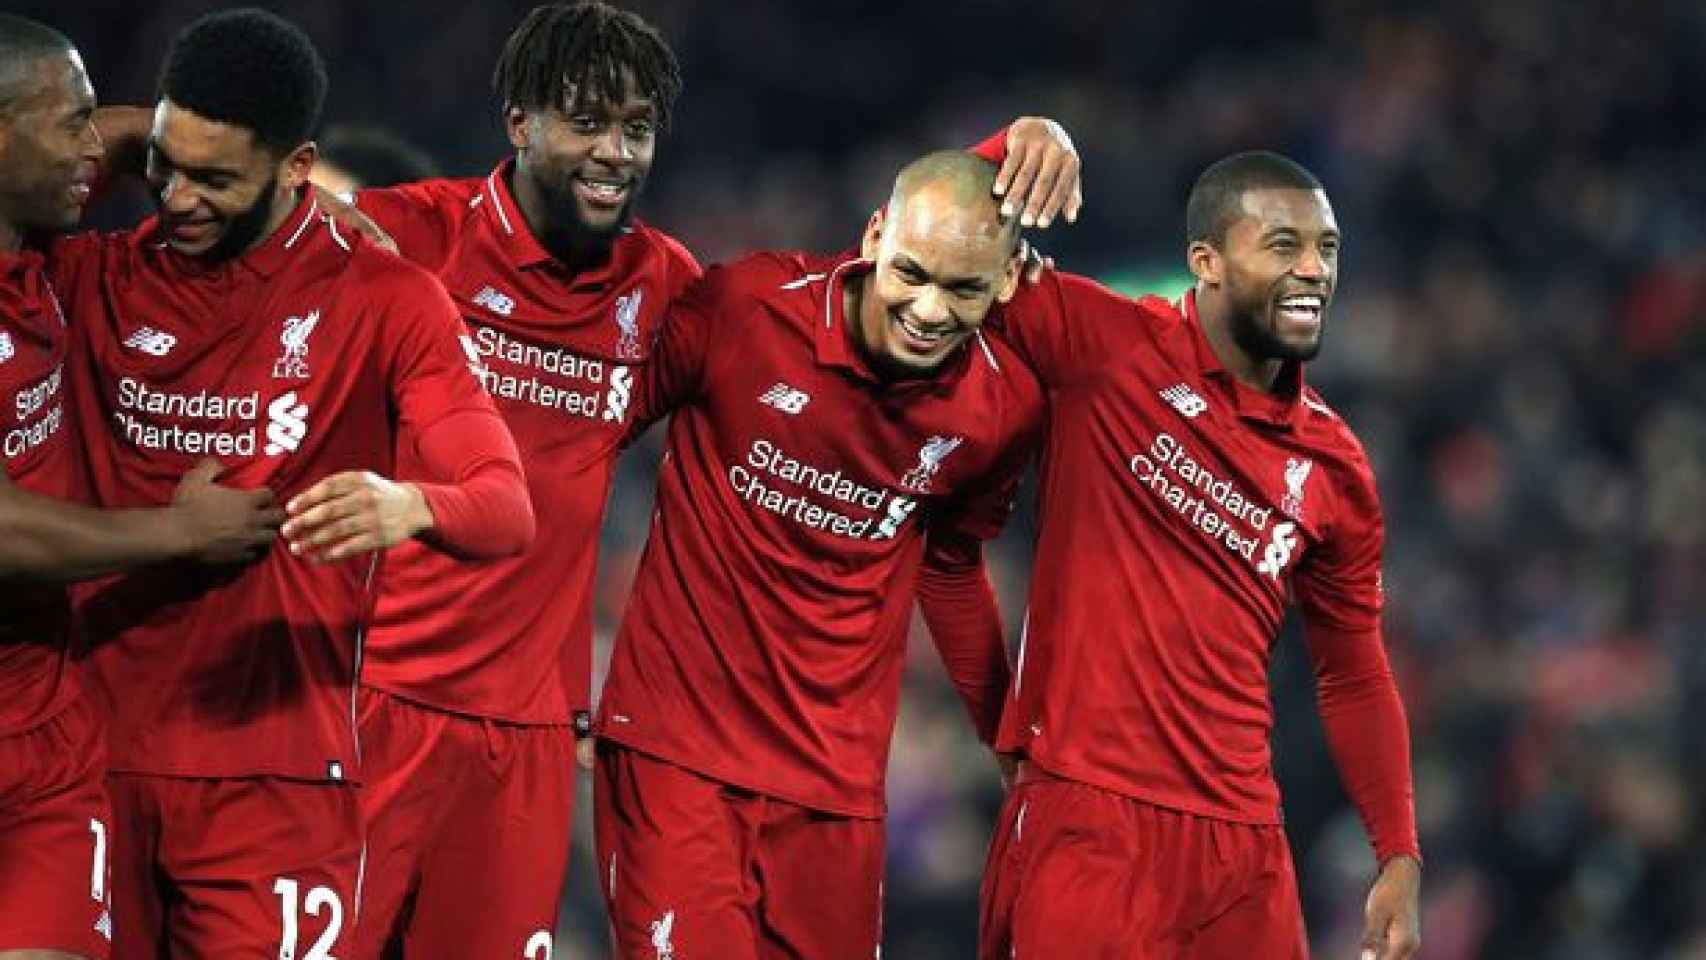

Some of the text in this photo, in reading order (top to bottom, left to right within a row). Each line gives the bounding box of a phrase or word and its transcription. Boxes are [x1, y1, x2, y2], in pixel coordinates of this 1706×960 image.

[467, 362, 600, 417] hartered
[477, 327, 603, 384] Standard
[114, 411, 256, 456] hartered
[119, 377, 258, 420] Standard
[729, 465, 873, 538] Chartered
[749, 440, 888, 510] Standard
[1131, 454, 1260, 560] Chartered
[1151, 432, 1272, 531] Standard
[273, 878, 344, 960] 12
